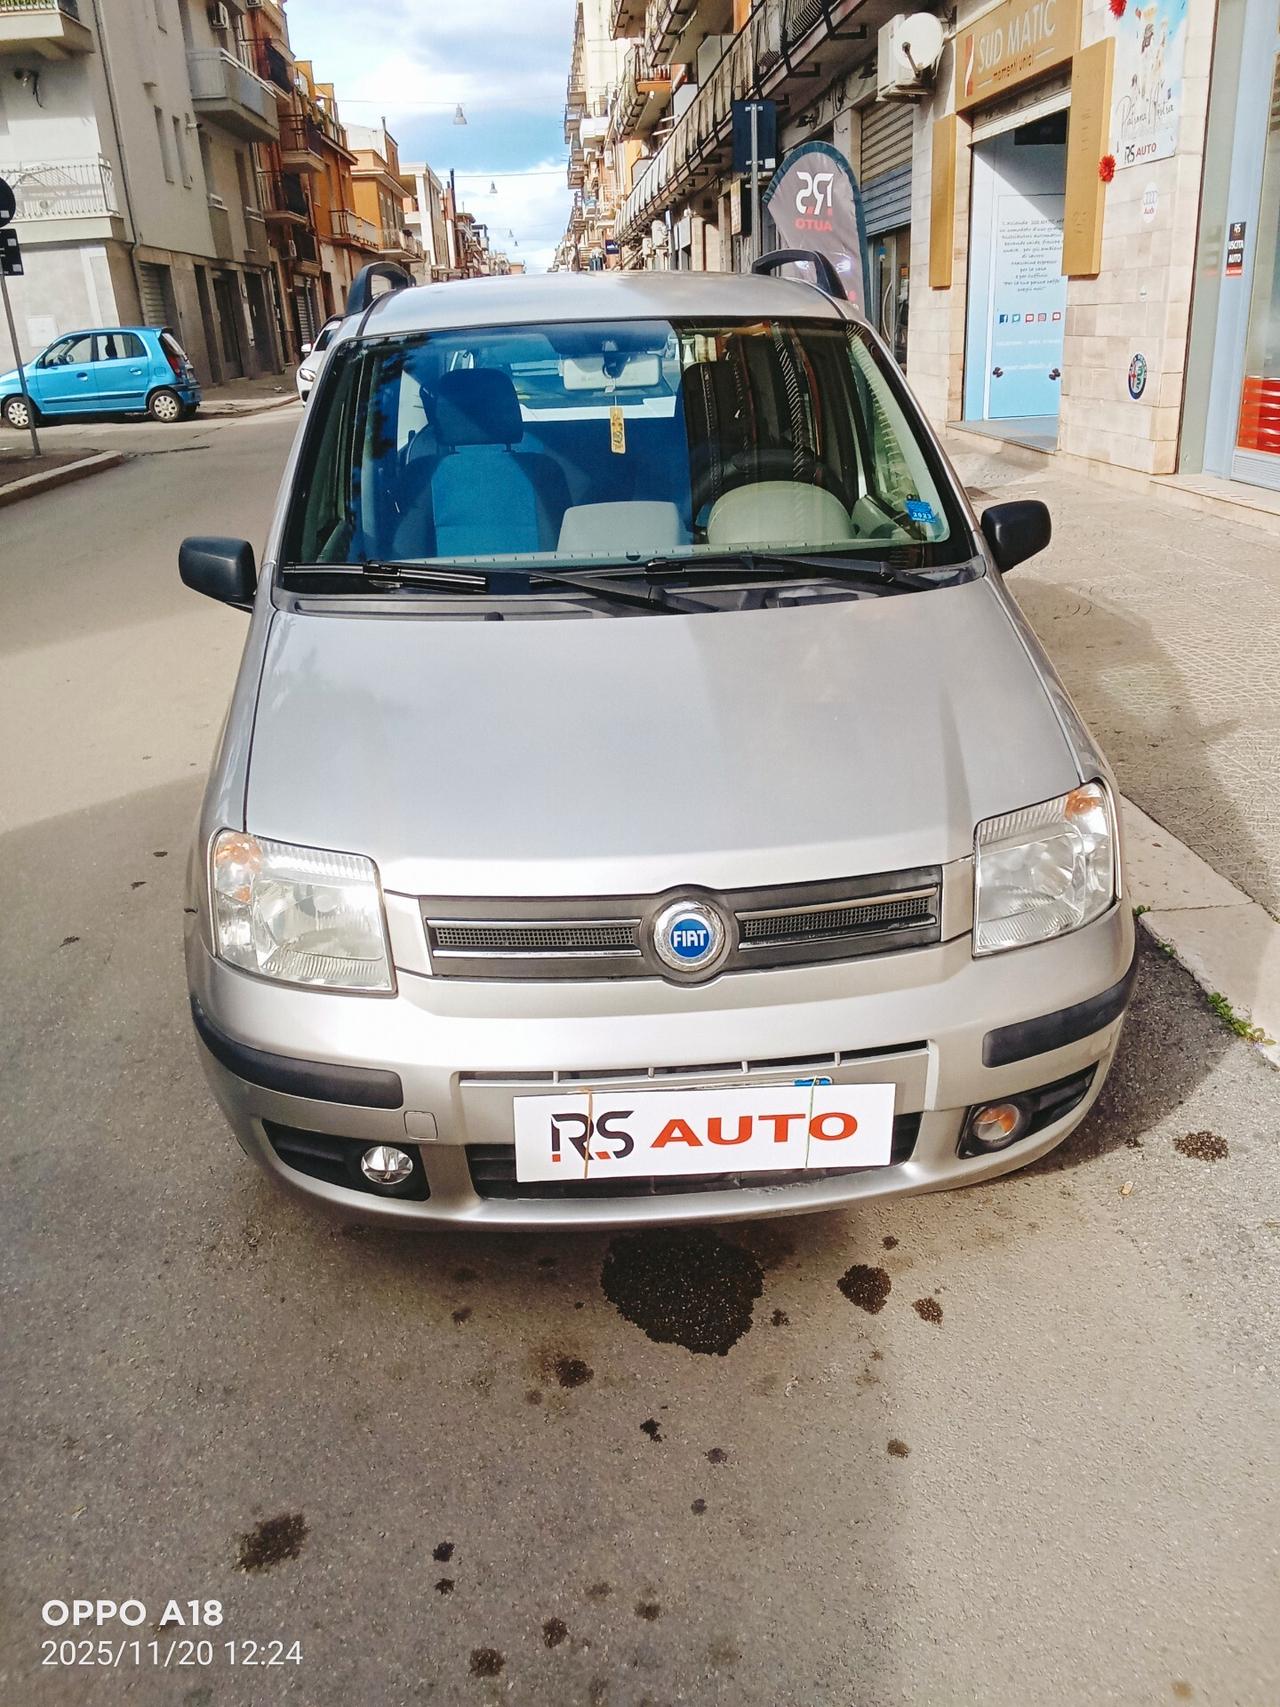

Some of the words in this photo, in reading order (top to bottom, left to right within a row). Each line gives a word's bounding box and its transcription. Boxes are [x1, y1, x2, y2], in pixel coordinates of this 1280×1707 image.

[978, 27, 1003, 74] SUD
[1007, 0, 1056, 54] MATIC
[1136, 142, 1157, 157] AUTO
[673, 929, 707, 948] FIAT
[551, 1110, 634, 1163] RS
[650, 1112, 858, 1149] AUTO
